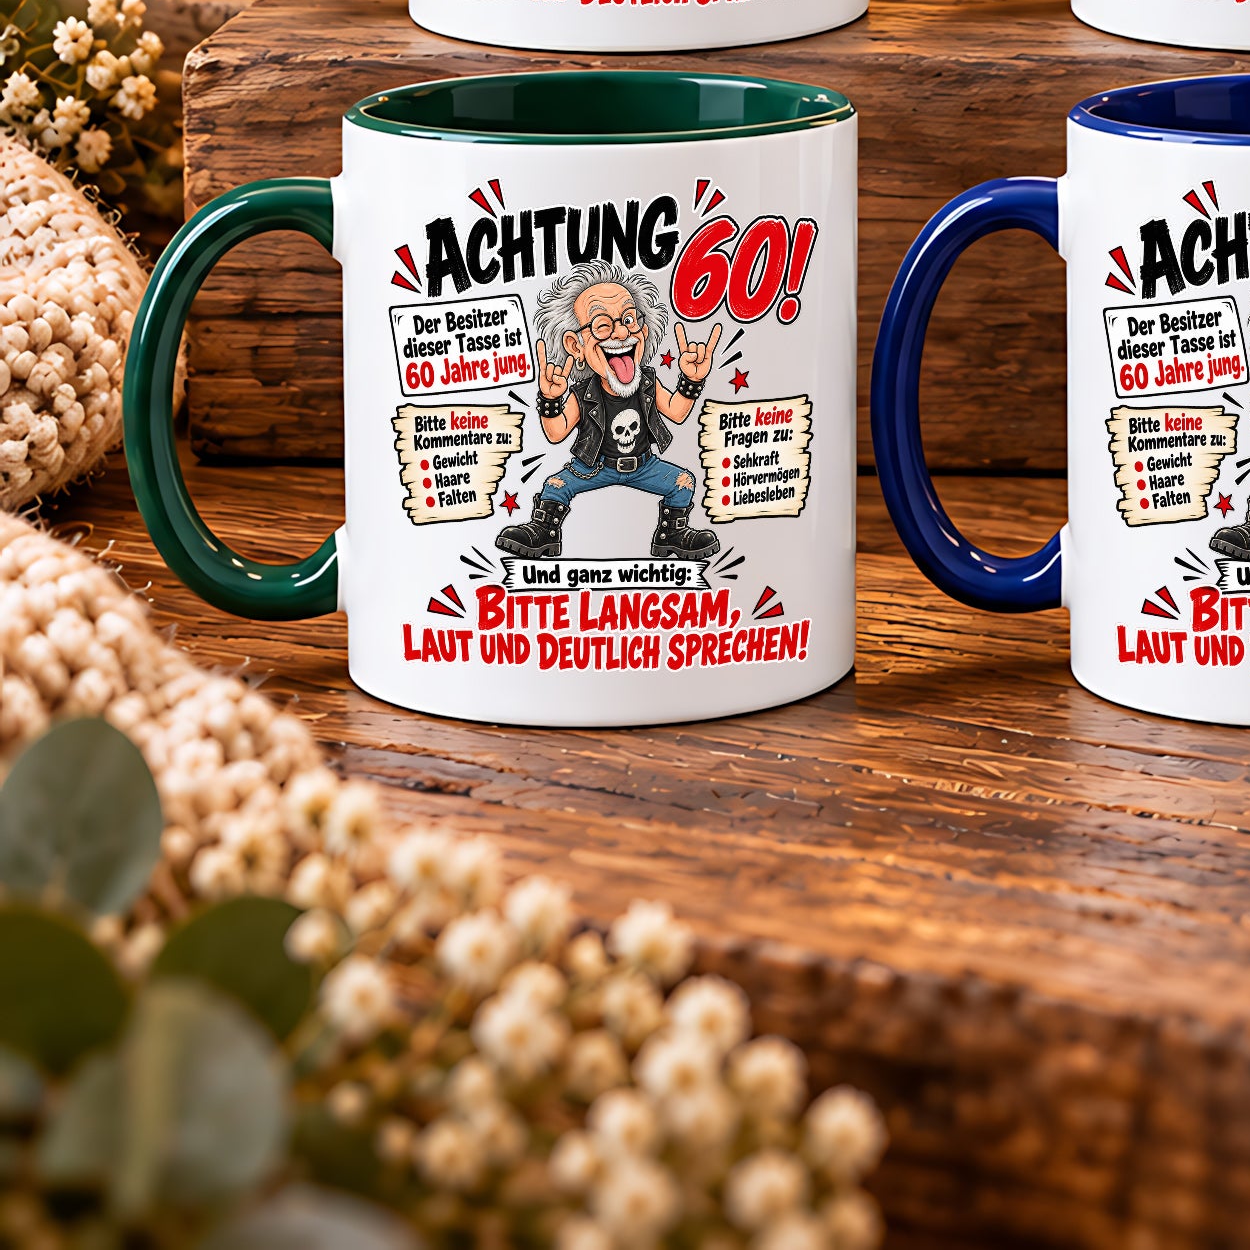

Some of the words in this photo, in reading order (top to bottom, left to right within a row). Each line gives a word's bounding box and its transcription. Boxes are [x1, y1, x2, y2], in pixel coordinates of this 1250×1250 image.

[426, 196, 679, 297] ACHTUNG
[671, 215, 819, 325] 60!
[413, 314, 441, 335] Der
[445, 308, 508, 332] Besitzer
[1127, 316, 1155, 337] Der
[1159, 310, 1222, 334] Besitzer
[1117, 341, 1165, 360] dieser
[1169, 336, 1215, 355] Tasse
[1218, 330, 1236, 348] ist
[405, 361, 435, 389] 60
[440, 355, 490, 385] Jahre
[492, 351, 531, 382] jung.
[1119, 363, 1149, 391] 60
[1154, 357, 1204, 387] Jahre
[1206, 353, 1245, 384] jung.
[414, 416, 446, 433] Bitte
[450, 411, 488, 430] keine
[413, 431, 492, 451] Kommentare
[496, 433, 512, 445] zu:
[432, 451, 478, 470] Gewicht
[435, 472, 470, 489] Haare
[437, 490, 477, 508] Falten
[522, 564, 560, 584] Und
[567, 569, 612, 587] ganz
[618, 564, 692, 586] wichtig:
[475, 584, 570, 631] BITTE
[579, 589, 740, 632] LANGSAM,
[402, 624, 473, 663] LAUT
[480, 633, 531, 665] UND
[536, 633, 660, 670] DEUTLICH
[667, 620, 810, 670] SPRECHEN!
[1117, 625, 1187, 664] LAUT
[1194, 635, 1245, 666] UND
